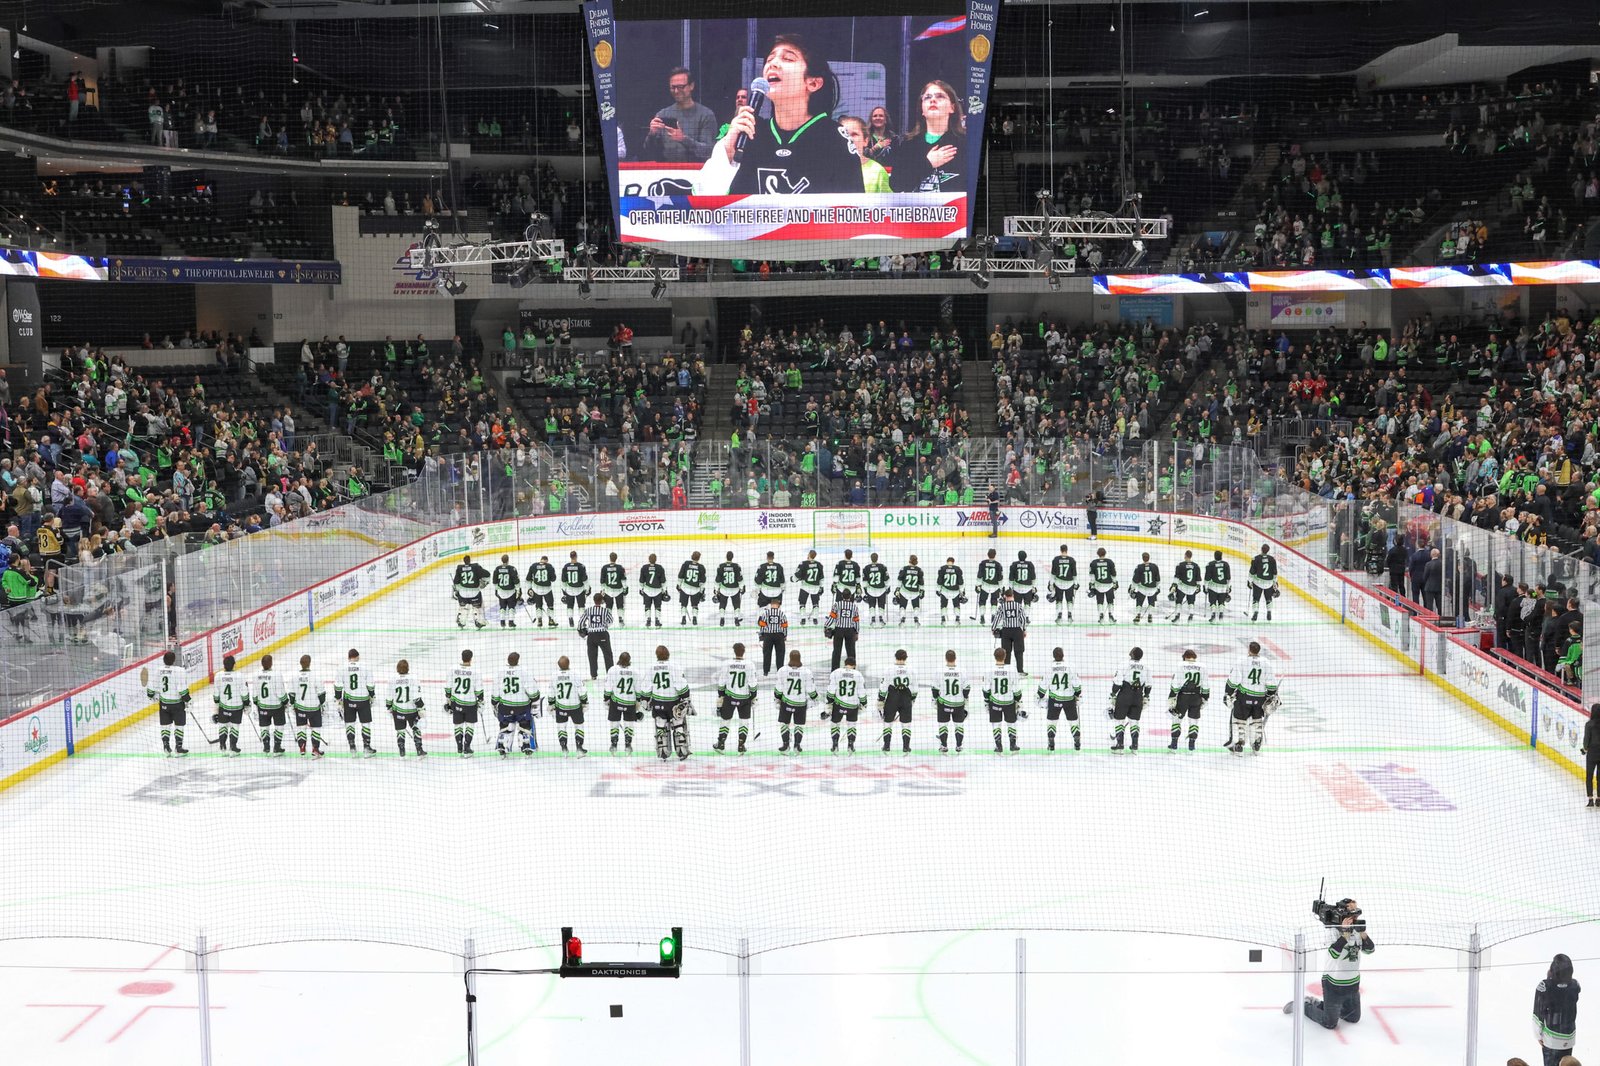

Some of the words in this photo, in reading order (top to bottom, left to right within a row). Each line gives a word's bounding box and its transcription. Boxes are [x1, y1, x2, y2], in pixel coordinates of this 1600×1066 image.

[972, 1, 992, 11] DREAM
[589, 9, 608, 19] DREAM
[970, 11, 993, 21] FINDERS
[590, 18, 610, 29] FINDERS
[970, 21, 991, 30] HOMES
[592, 27, 610, 37] HOMES
[630, 210, 654, 225] O'ER
[658, 210, 679, 224] THE
[682, 210, 711, 224] LAND
[715, 210, 728, 224] OF
[732, 209, 752, 223] THE
[757, 209, 783, 223] FREE
[787, 209, 809, 223] AND
[813, 209, 834, 222] THE
[837, 208, 869, 222] HOME
[872, 208, 885, 222] OF
[890, 208, 911, 222] THE
[915, 207, 957, 222] BRAVE?
[121, 266, 167, 277] SECRETS
[185, 268, 201, 277] THE
[202, 269, 238, 278] OFFICIAL
[239, 270, 274, 278] JEWELER
[300, 270, 339, 280] SECRETS
[19, 328, 33, 336] CLUB
[557, 515, 597, 535] Kirklands
[884, 513, 940, 526] Publix
[1037, 511, 1079, 528] VyStar
[619, 523, 664, 531] TOYOTA
[534, 570, 548, 582] 48
[686, 570, 699, 582] 95
[765, 570, 778, 583] 34
[807, 569, 819, 581] 27
[842, 570, 855, 582] 26
[985, 568, 995, 580] 19
[1017, 569, 1028, 581] 18
[1059, 564, 1070, 577] 17
[1097, 567, 1108, 580] 15
[1186, 569, 1193, 582] 9
[1217, 568, 1224, 580] 5
[1263, 564, 1269, 576] 2
[461, 571, 474, 584] 32
[499, 573, 509, 586] 28
[567, 571, 578, 583] 10
[607, 572, 618, 585] 12
[649, 572, 655, 584] 7
[723, 571, 735, 584] 38
[869, 572, 881, 585] 23
[905, 575, 918, 588] 22
[944, 573, 957, 586] 20
[1144, 571, 1152, 583] 11
[350, 673, 358, 690] 8
[653, 672, 670, 689] 45
[730, 671, 746, 688] 70
[1052, 673, 1068, 690] 44
[1133, 671, 1140, 682] 5
[1184, 672, 1200, 686] 20
[1248, 668, 1262, 685] 41
[162, 676, 168, 692] 3
[261, 682, 269, 698] 6
[454, 677, 471, 695] 29
[503, 677, 520, 694] 35
[617, 677, 634, 695] 42
[787, 678, 802, 695] 74
[839, 679, 856, 696] 83
[945, 678, 959, 695] 16
[994, 677, 1008, 695] 18
[224, 684, 232, 700] 4
[300, 684, 307, 700] 7
[396, 686, 410, 703] 21
[557, 682, 573, 700] 37
[75, 689, 116, 728] Publix
[588, 779, 966, 798] LEXUS
